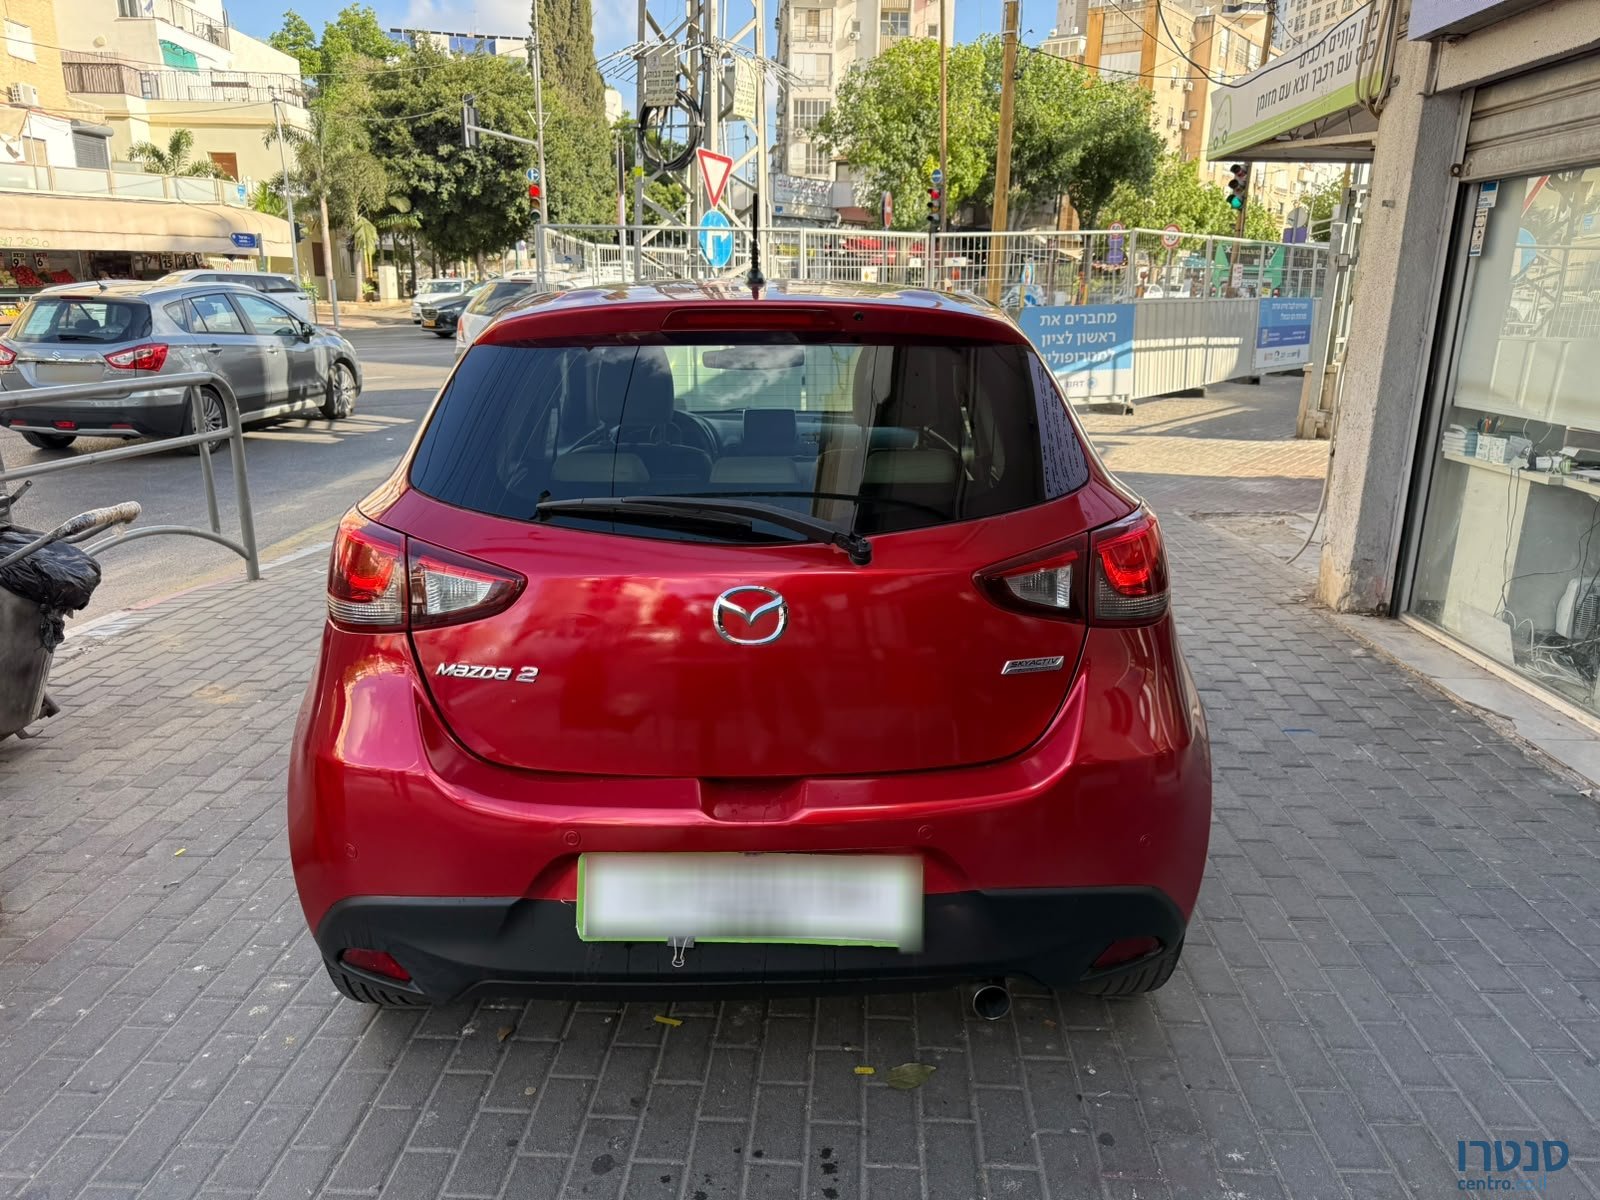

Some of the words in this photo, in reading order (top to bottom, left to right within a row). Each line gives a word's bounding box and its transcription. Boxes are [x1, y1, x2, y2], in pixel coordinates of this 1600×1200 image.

[1329, 22, 1357, 52] קונים
[1299, 40, 1326, 69] רכבים
[1337, 51, 1352, 75] עם
[1293, 75, 1309, 96] וצא
[1312, 61, 1334, 91] רכבך
[1278, 82, 1291, 101] עם
[1256, 88, 1277, 117] מזומן
[1039, 314, 1062, 327] את
[1064, 312, 1117, 325] מחברים
[1041, 330, 1073, 347] לציון
[1076, 331, 1117, 346] ראשון
[1010, 657, 1058, 668] SKYACTIV
[516, 666, 539, 683] 2
